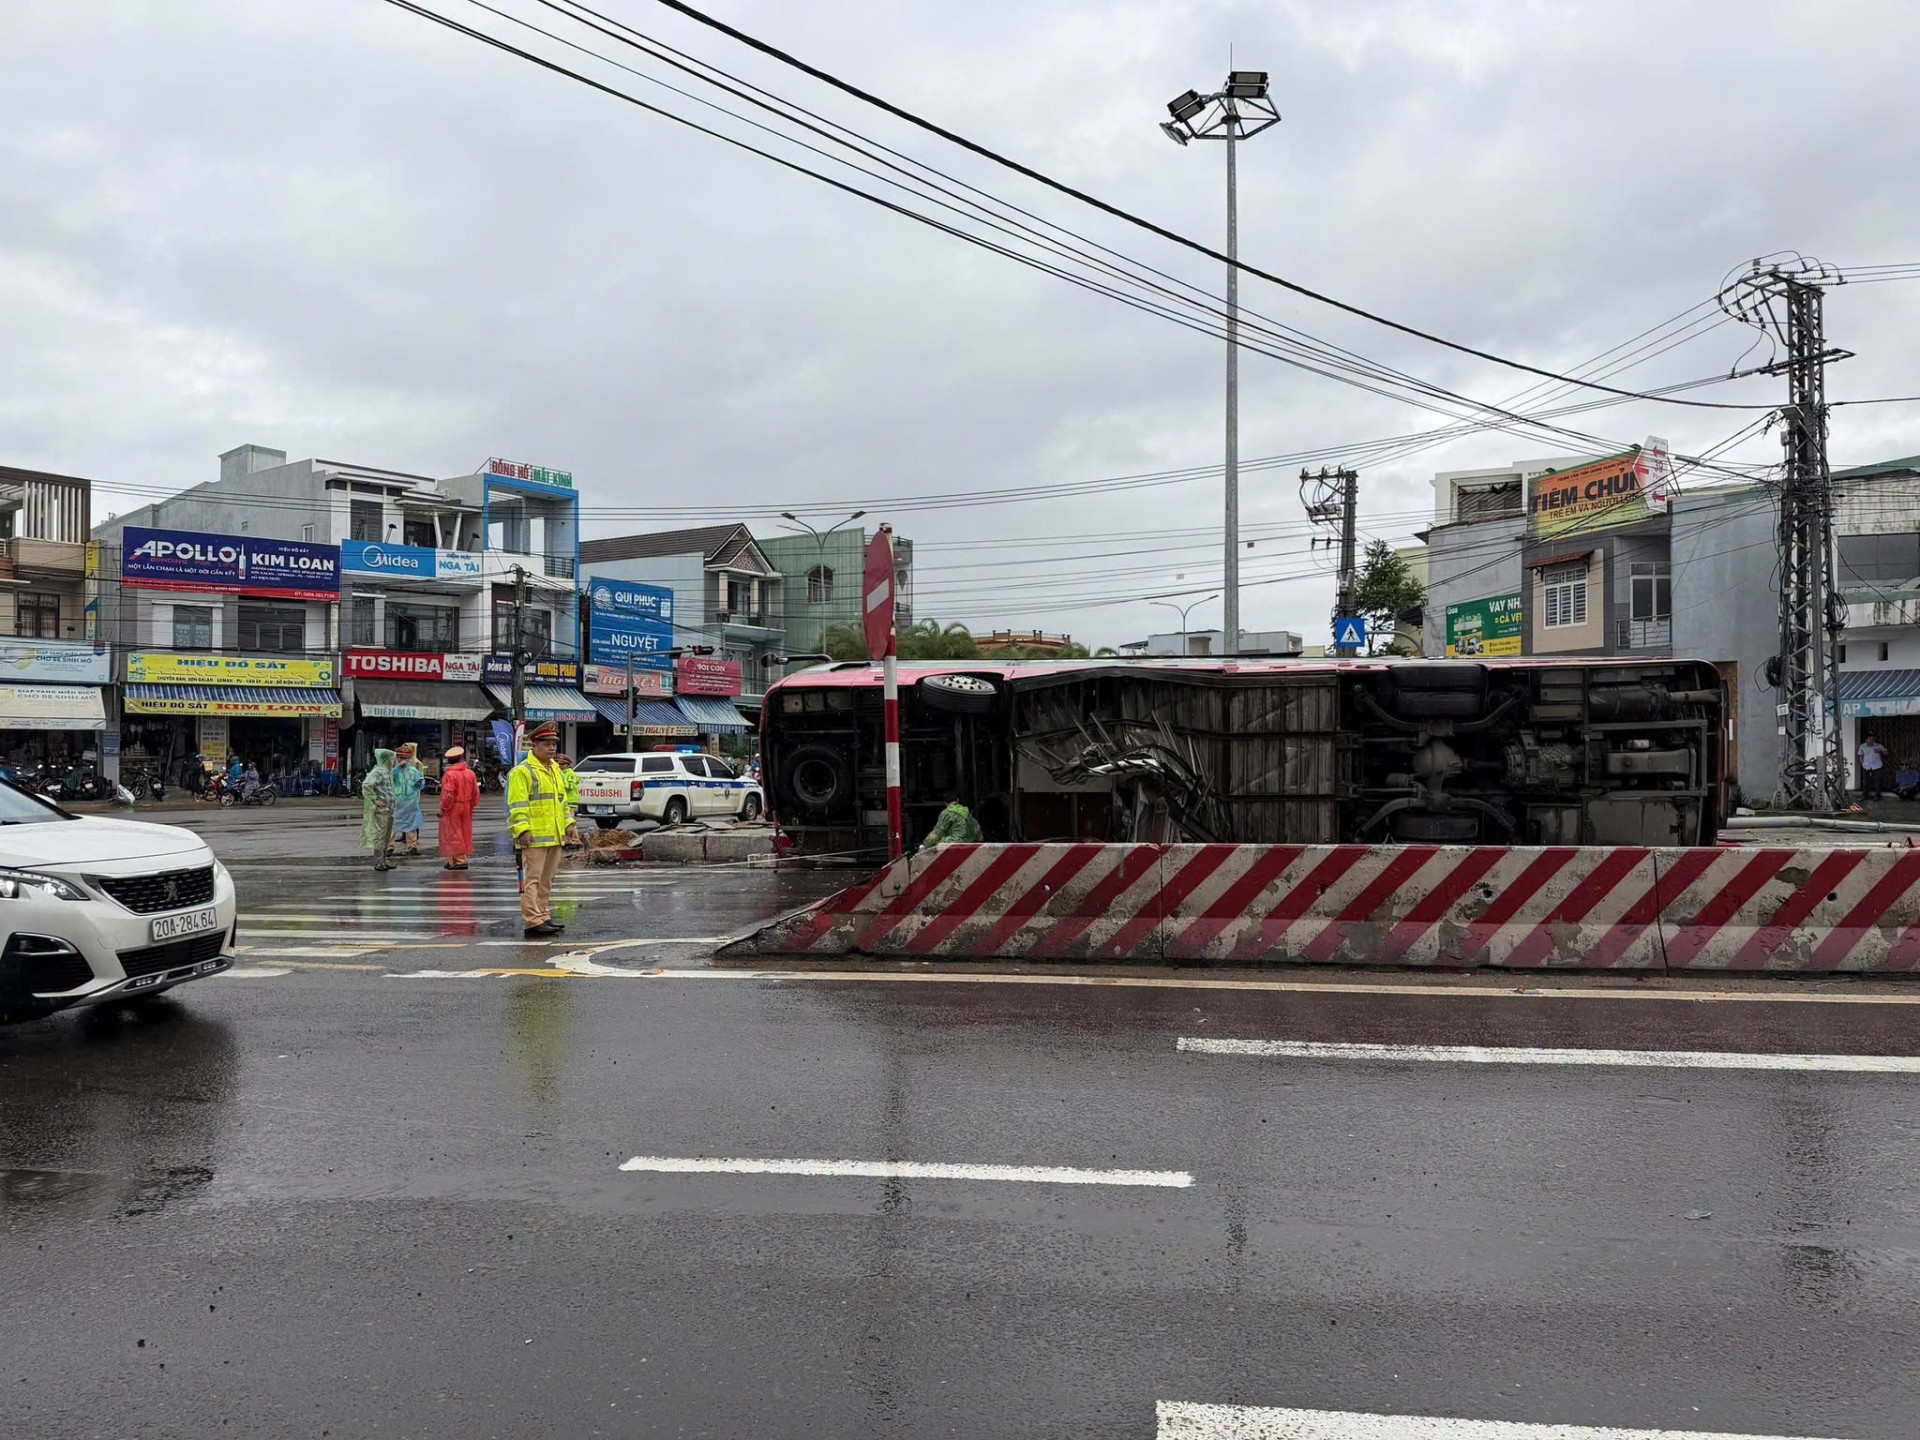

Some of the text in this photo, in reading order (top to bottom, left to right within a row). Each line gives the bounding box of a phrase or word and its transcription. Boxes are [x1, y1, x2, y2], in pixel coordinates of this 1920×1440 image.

[1585, 467, 1640, 501] CHỦN
[1565, 506, 1577, 516] EM
[128, 540, 237, 562] APOLLO
[370, 550, 419, 569] Midea
[252, 552, 335, 572] KIM LOAN
[439, 560, 480, 573] NGA TÀI
[614, 591, 632, 605] QUI
[1488, 597, 1522, 613] VAY NH
[611, 633, 659, 652] NGUYỆT
[347, 655, 442, 674] TOSHIBA
[445, 661, 480, 671] NGA TÀI
[559, 662, 577, 677] PHÁT
[217, 702, 260, 711] KIM
[154, 911, 214, 938] 20A-284.64
